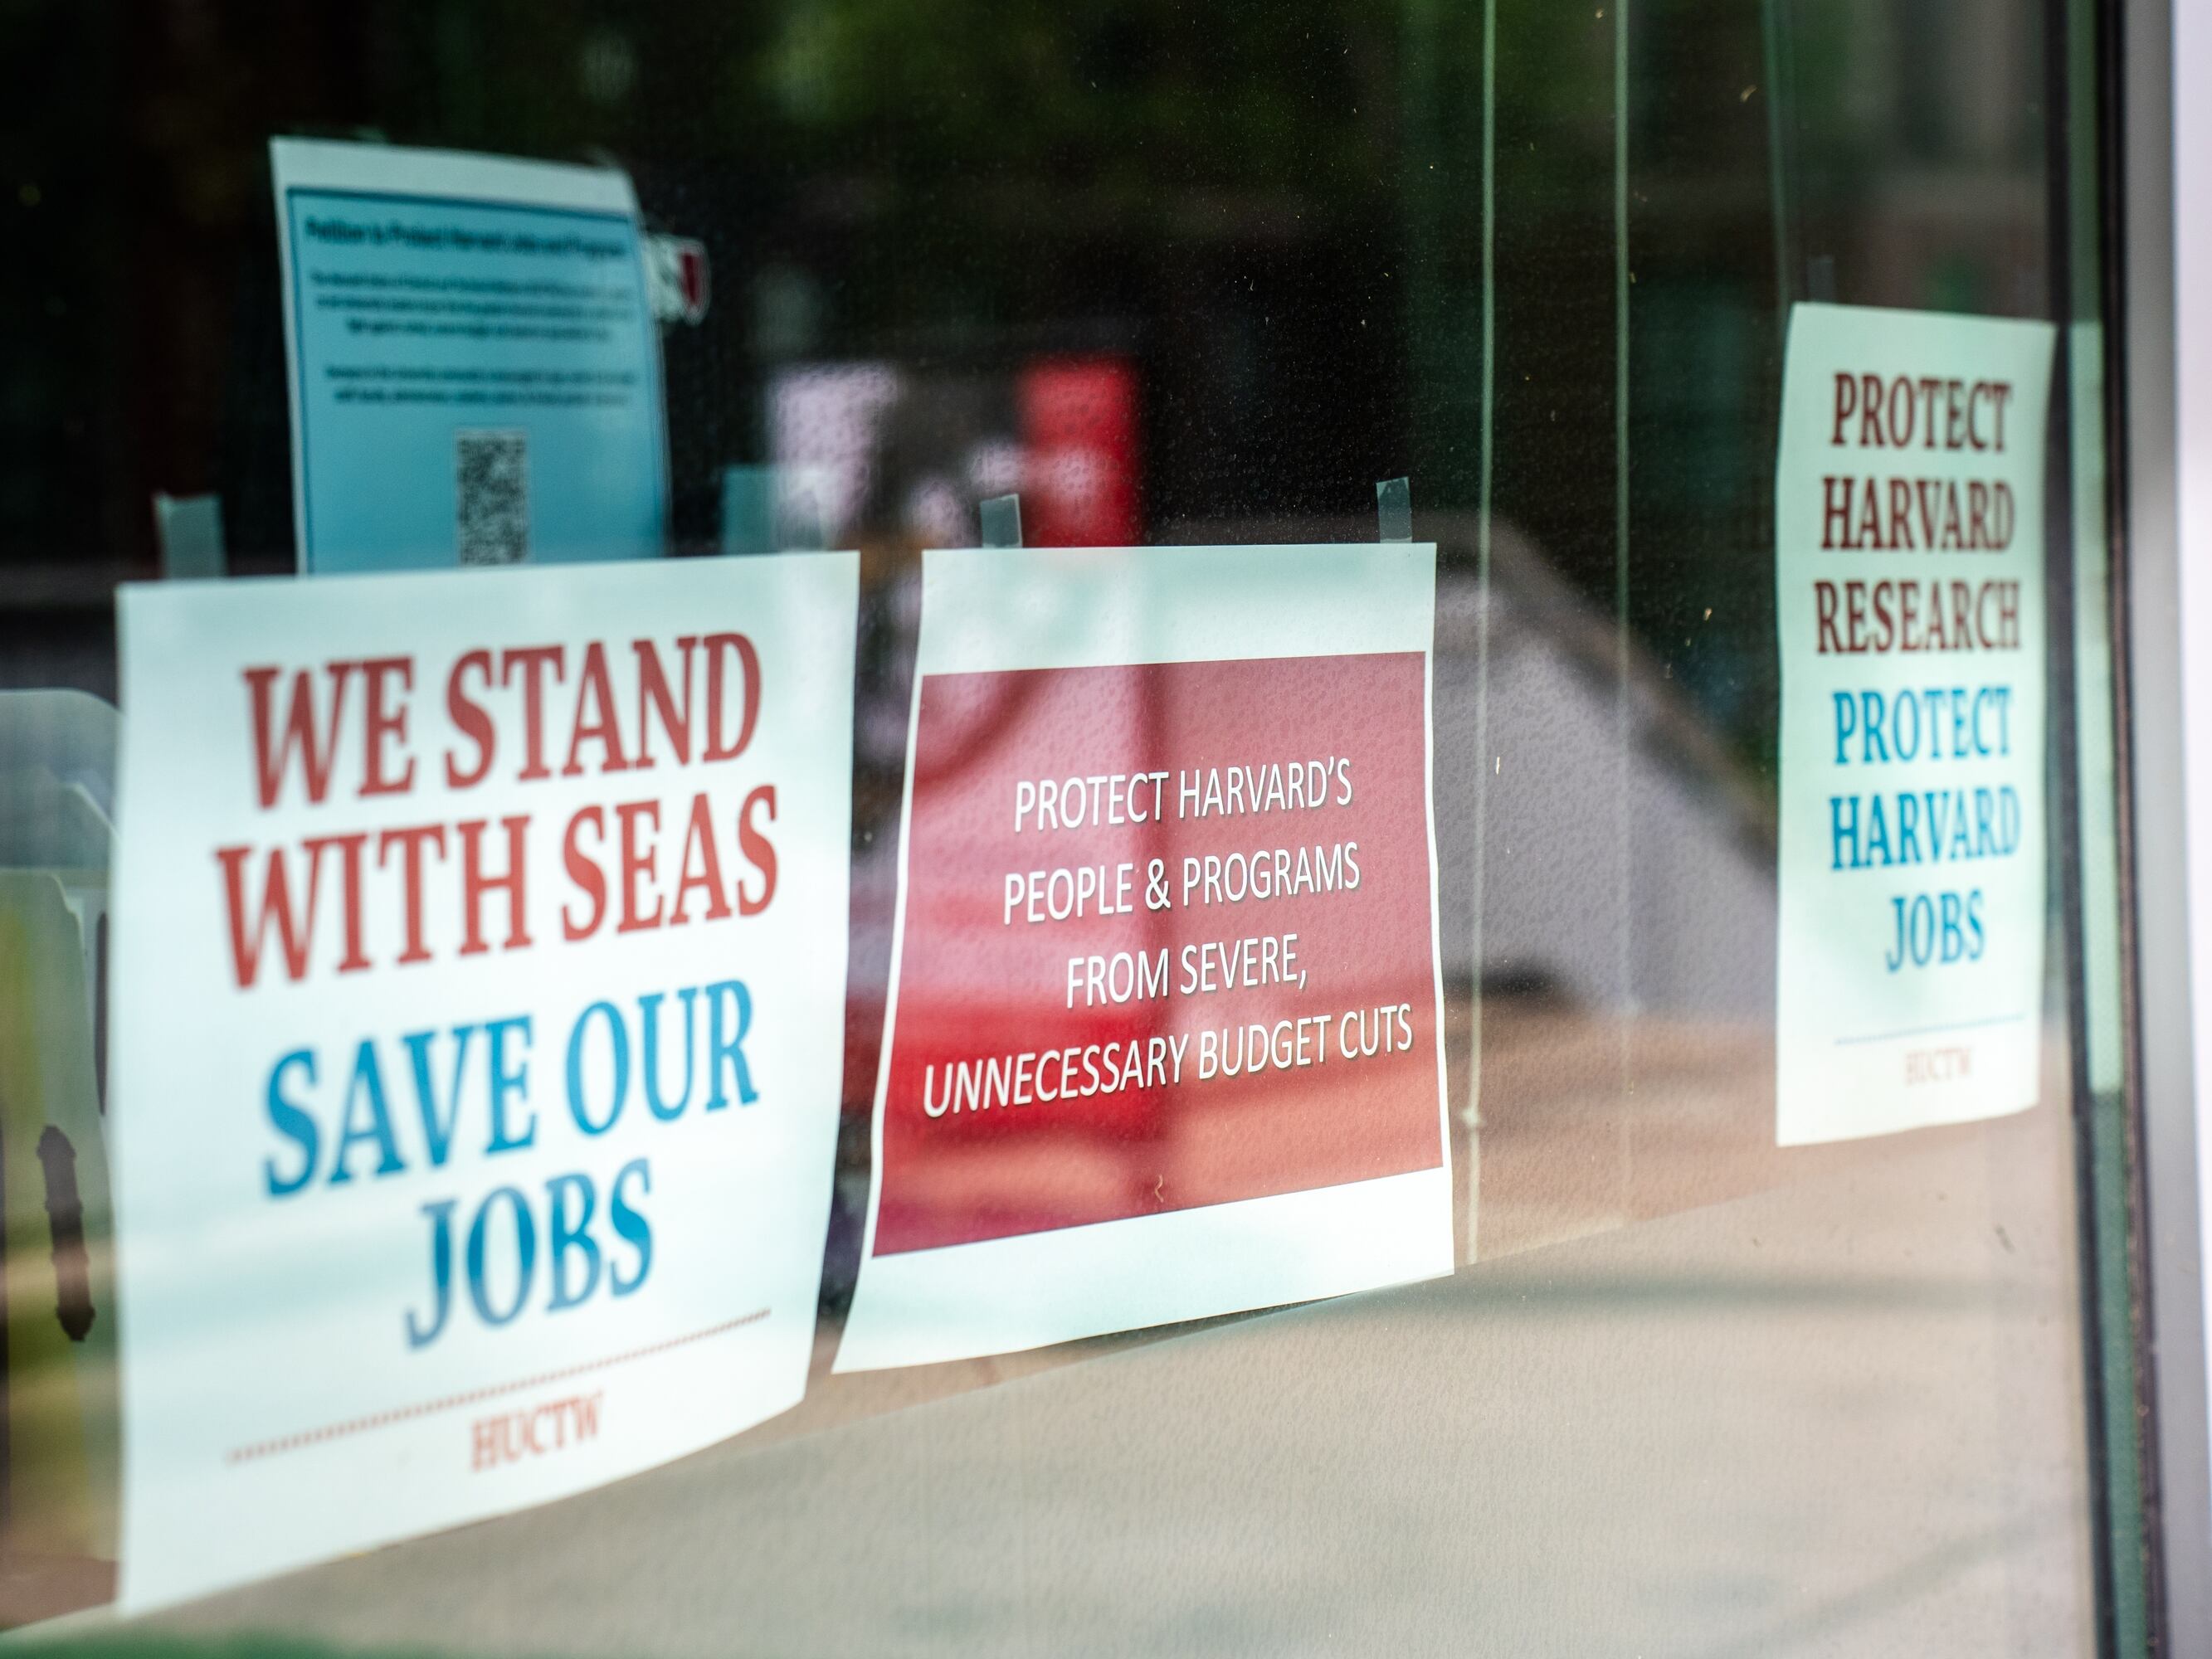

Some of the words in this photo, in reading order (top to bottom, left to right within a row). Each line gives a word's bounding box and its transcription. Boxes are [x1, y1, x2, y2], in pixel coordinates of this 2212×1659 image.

[1831, 372, 2012, 452] PROTECT
[1821, 476, 2015, 551] HARVARD
[1814, 580, 2021, 654] RESEARCH
[244, 650, 415, 809] WE
[446, 632, 761, 789] STAND
[1830, 684, 2013, 766] PROTECT
[1015, 771, 1170, 832] PROTECT
[1827, 784, 2021, 872] HARVARD
[216, 814, 533, 989] WITH
[562, 783, 778, 942] SEAS
[1004, 862, 1133, 925] PEOPLE
[1145, 858, 1172, 910] &
[1183, 841, 1360, 907] PROGRAMS
[1066, 947, 1169, 1009] FROM
[1180, 933, 1308, 995] SEVERE,
[1886, 888, 1985, 975] JOBS
[264, 1014, 537, 1199] SAVE
[564, 979, 759, 1137] OUR
[923, 1034, 1190, 1118] UNNECESSARY
[1198, 1014, 1332, 1079] BUDGET
[1339, 1003, 1412, 1058] CUTS
[406, 1160, 653, 1349] JOBS
[470, 1392, 603, 1472] HUCTW
